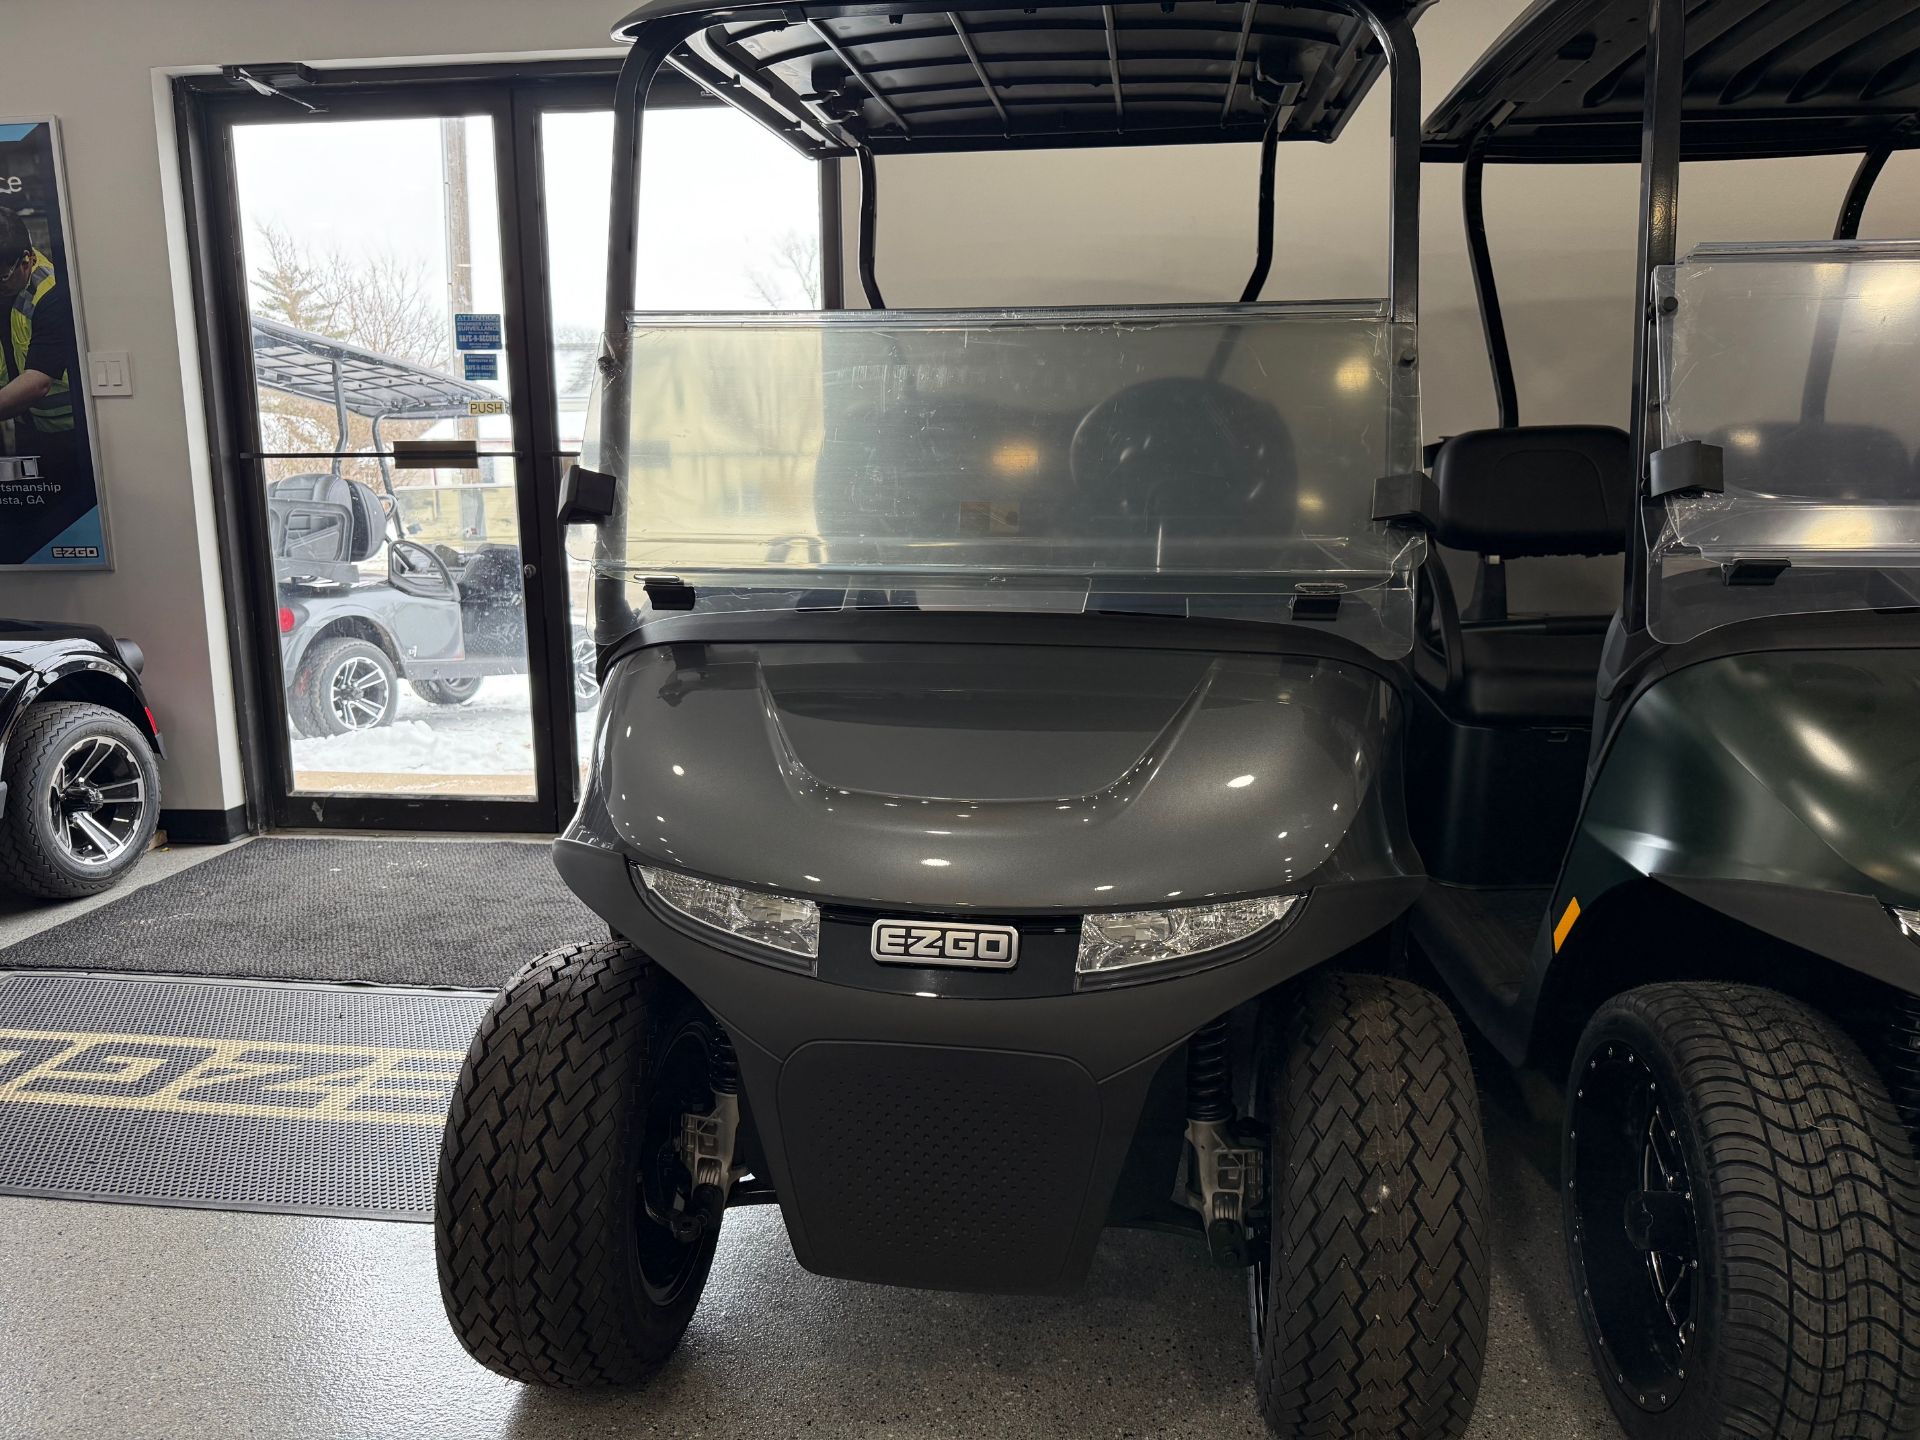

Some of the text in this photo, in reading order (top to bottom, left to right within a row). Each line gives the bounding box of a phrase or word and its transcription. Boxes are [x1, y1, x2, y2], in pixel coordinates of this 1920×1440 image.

[470, 403, 502, 414] PUSH
[0, 495, 45, 506] sta, GA
[878, 925, 1010, 961] EZGO
